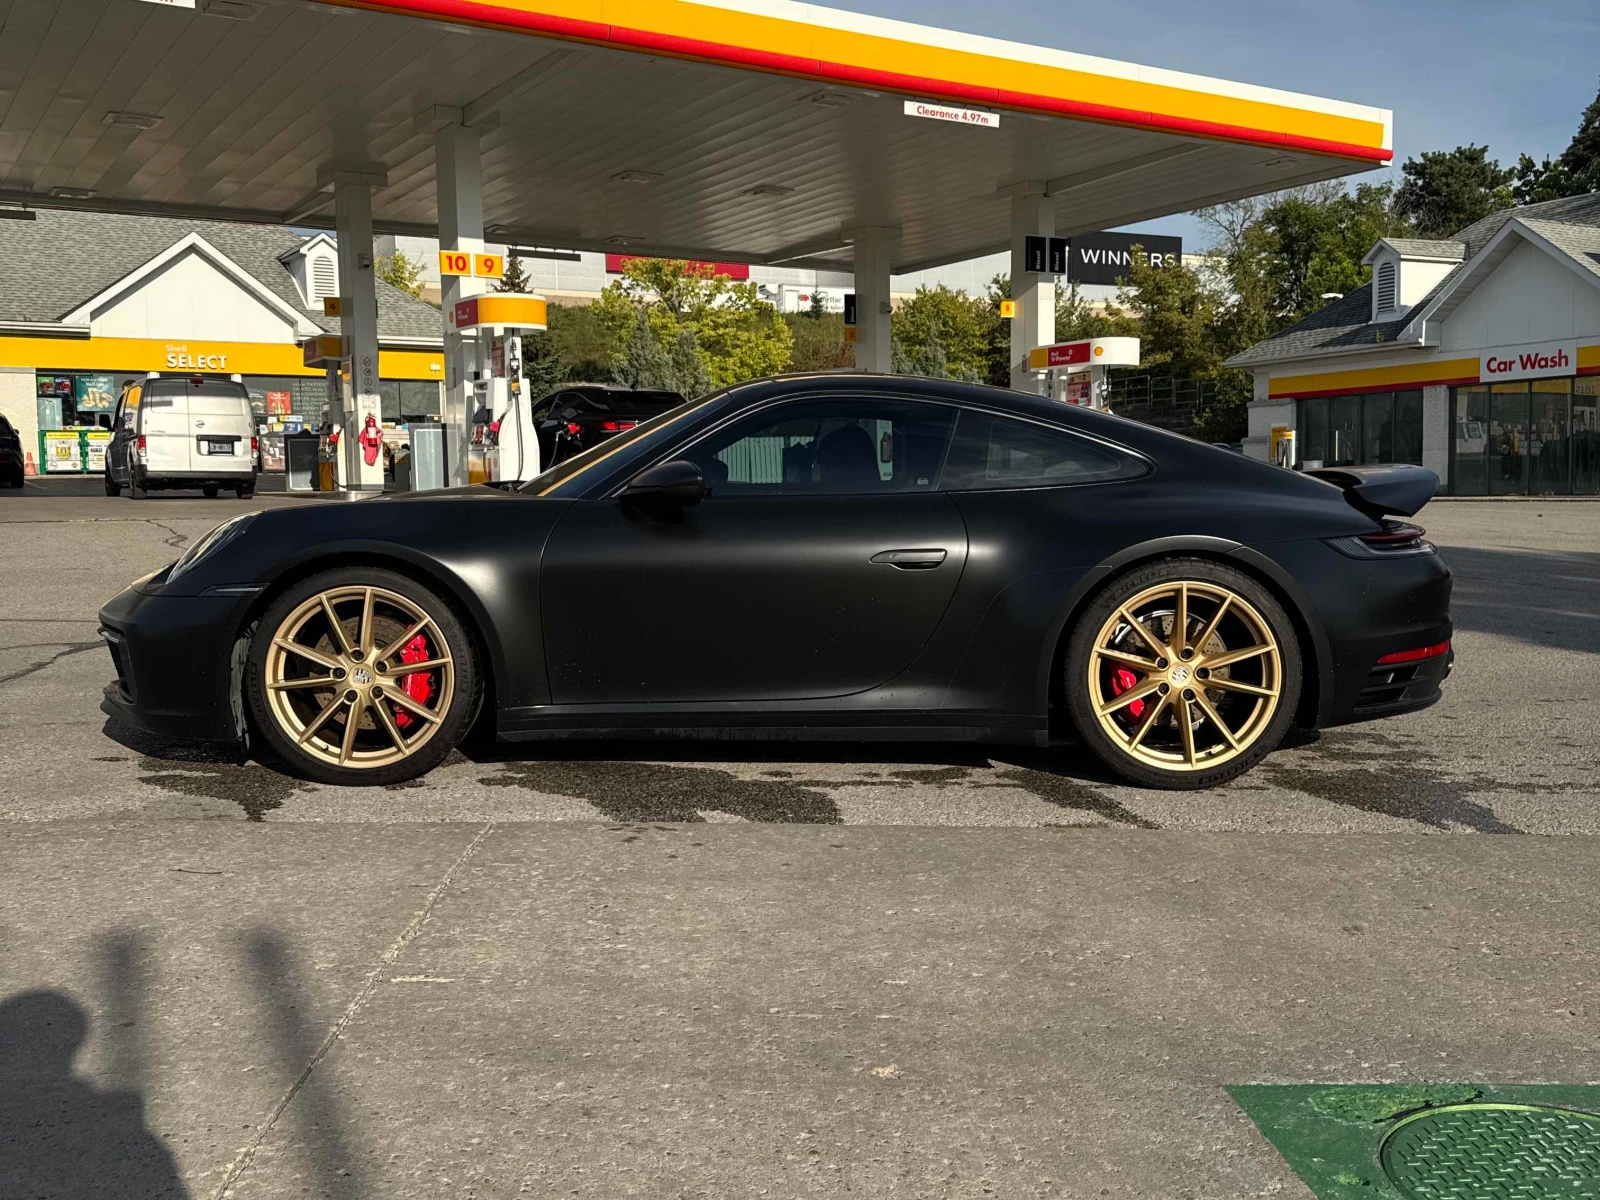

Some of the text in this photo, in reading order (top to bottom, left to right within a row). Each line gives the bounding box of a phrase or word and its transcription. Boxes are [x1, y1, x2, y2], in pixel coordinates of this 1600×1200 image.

[916, 105, 989, 124] Clearance 4.97m
[446, 255, 467, 272] 10
[483, 257, 495, 274] 9
[165, 343, 188, 353] Shell
[166, 353, 228, 370] SELECT
[1486, 348, 1569, 373] Car Wash
[269, 446, 280, 458] $1
